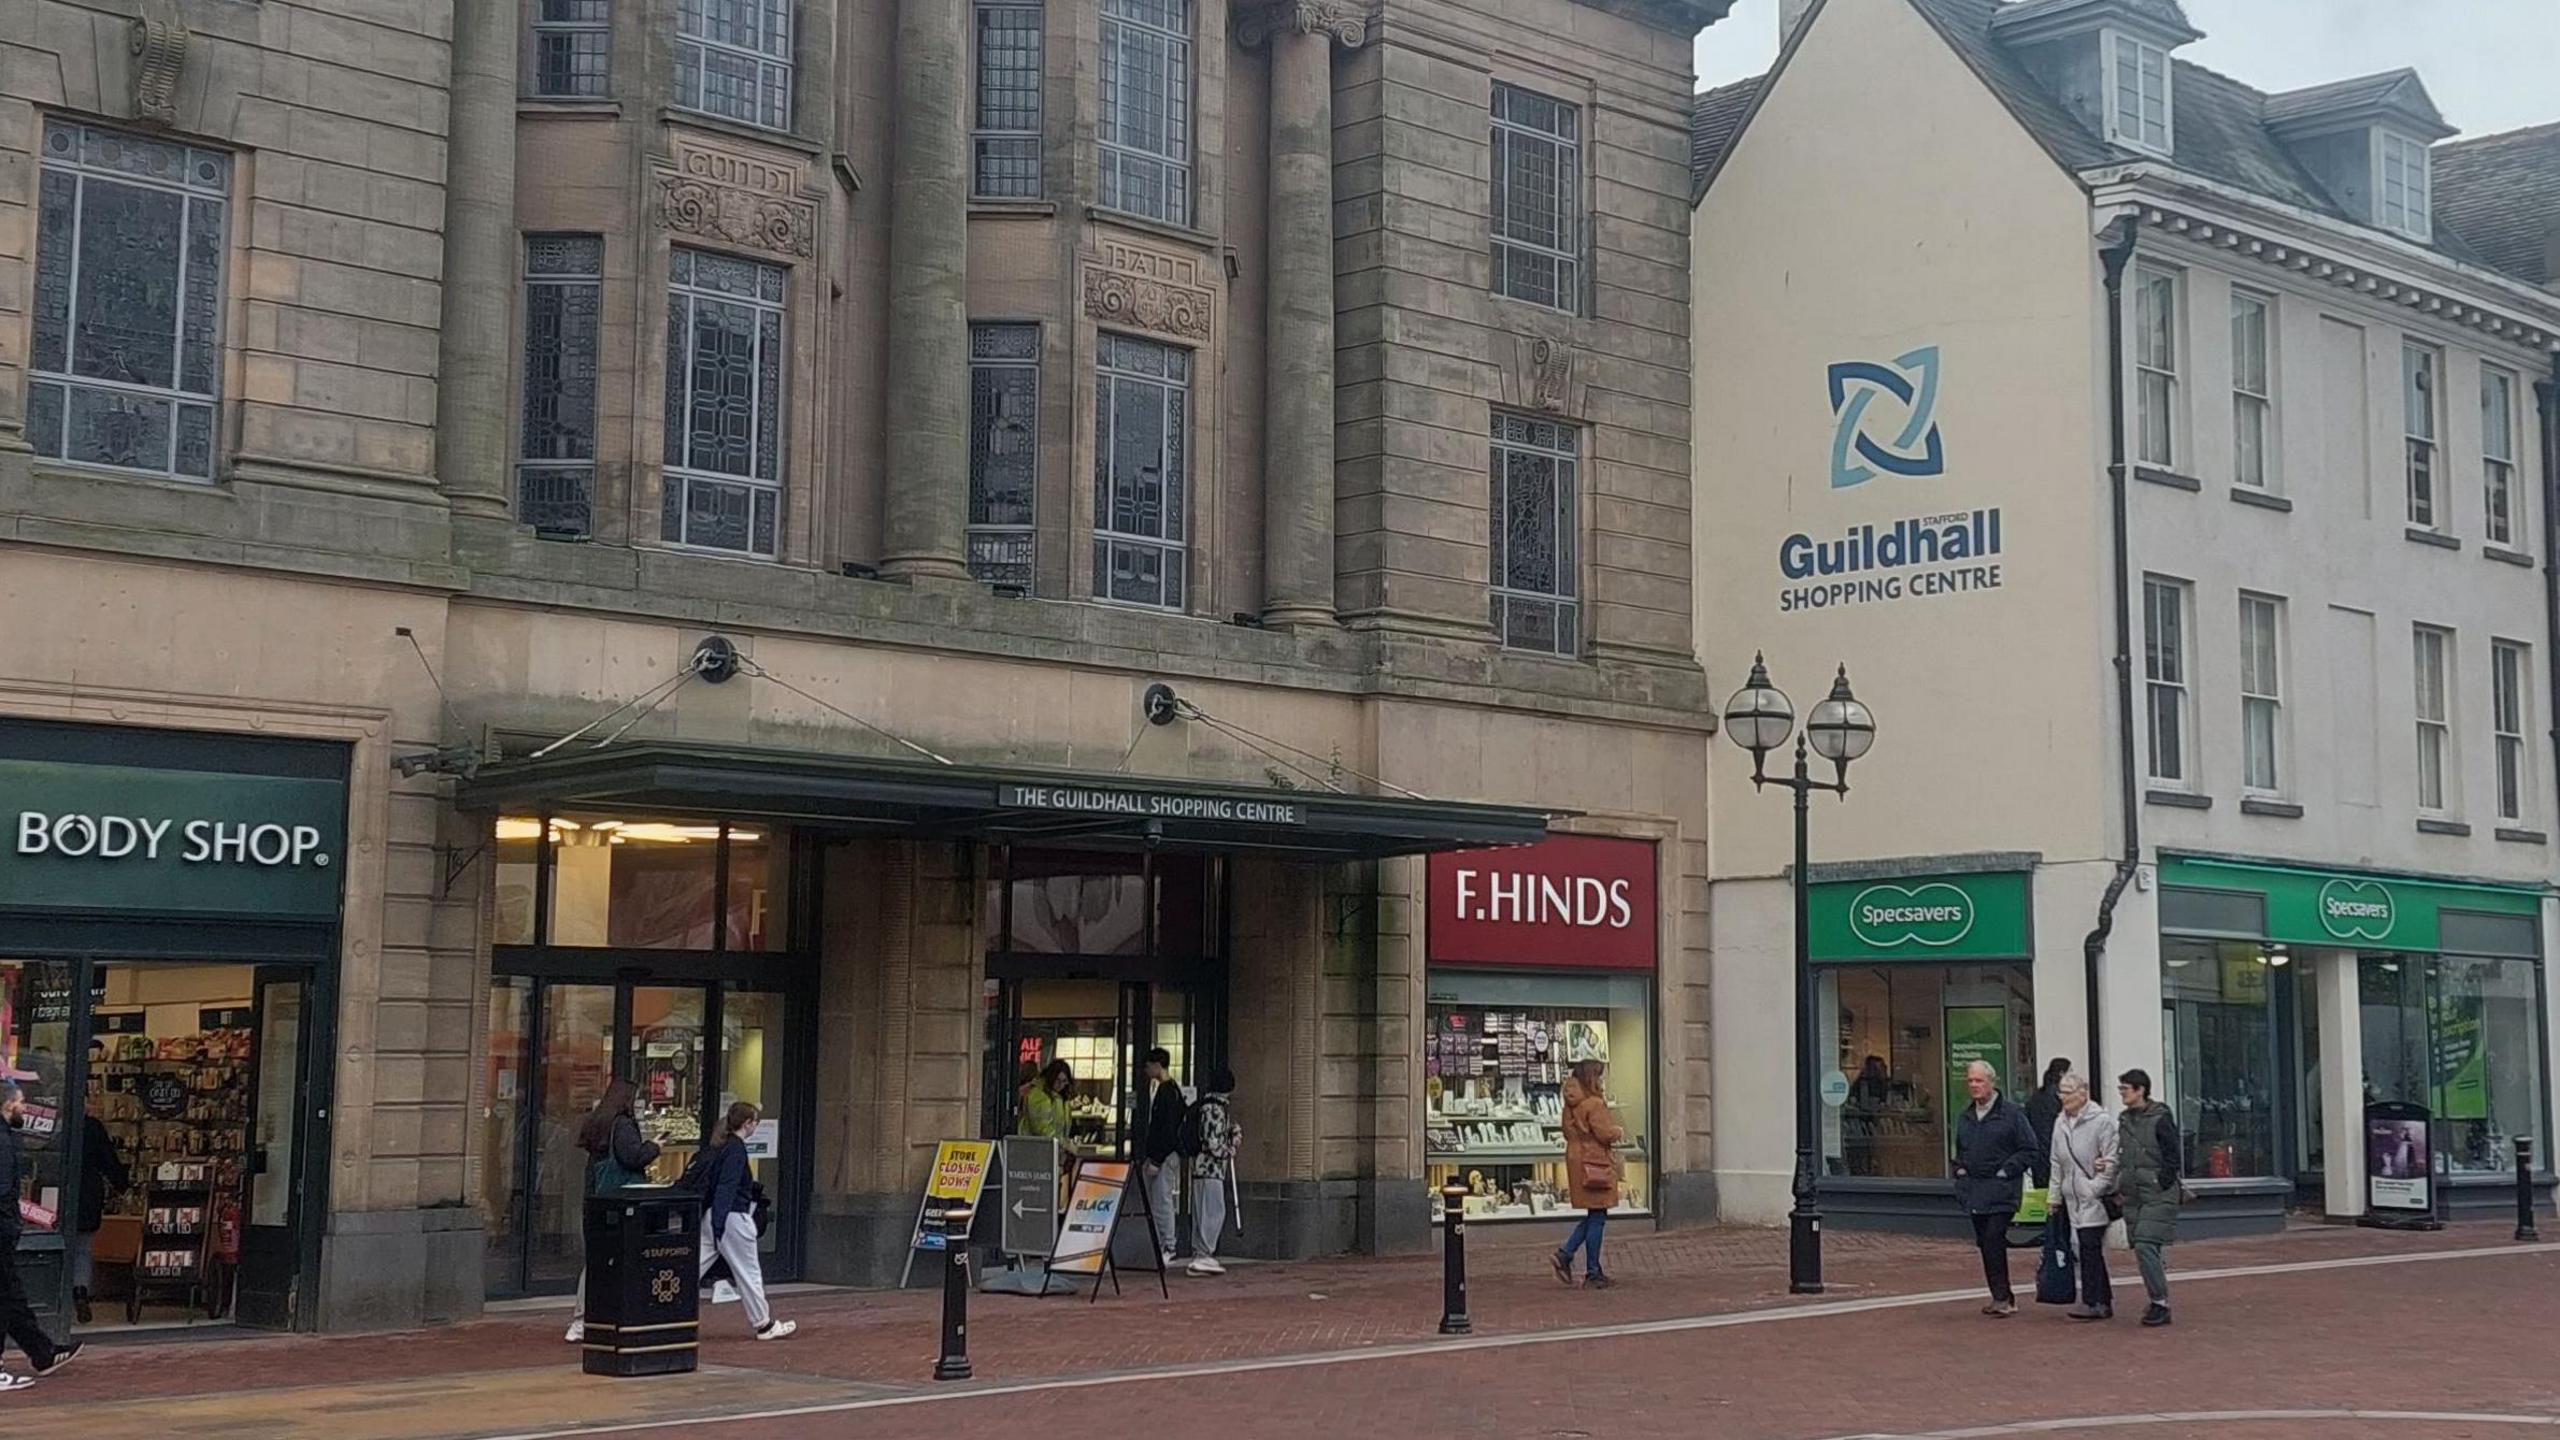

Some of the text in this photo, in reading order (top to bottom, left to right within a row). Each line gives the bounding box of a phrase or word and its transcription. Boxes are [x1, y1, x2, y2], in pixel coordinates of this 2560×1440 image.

[688, 152, 783, 192] GUILD
[1110, 246, 1194, 286] HALL
[1923, 512, 1969, 527] STAFFORD
[1780, 508, 2001, 579] Guildhall
[1780, 565, 2002, 612] SHOPPING CENTRE
[1015, 787, 1295, 823] THE GUILDHALL SHOPPING CENTRE
[17, 811, 172, 860] BODY
[1456, 868, 1632, 929] F.HINDS
[2326, 896, 2388, 919] Specsavers
[1862, 903, 1962, 927] Specsavers
[939, 1162, 981, 1175] CLOSING
[949, 1150, 977, 1161] STORE
[940, 1176, 971, 1187] DOWN
[1075, 1199, 1115, 1212] BLACK
